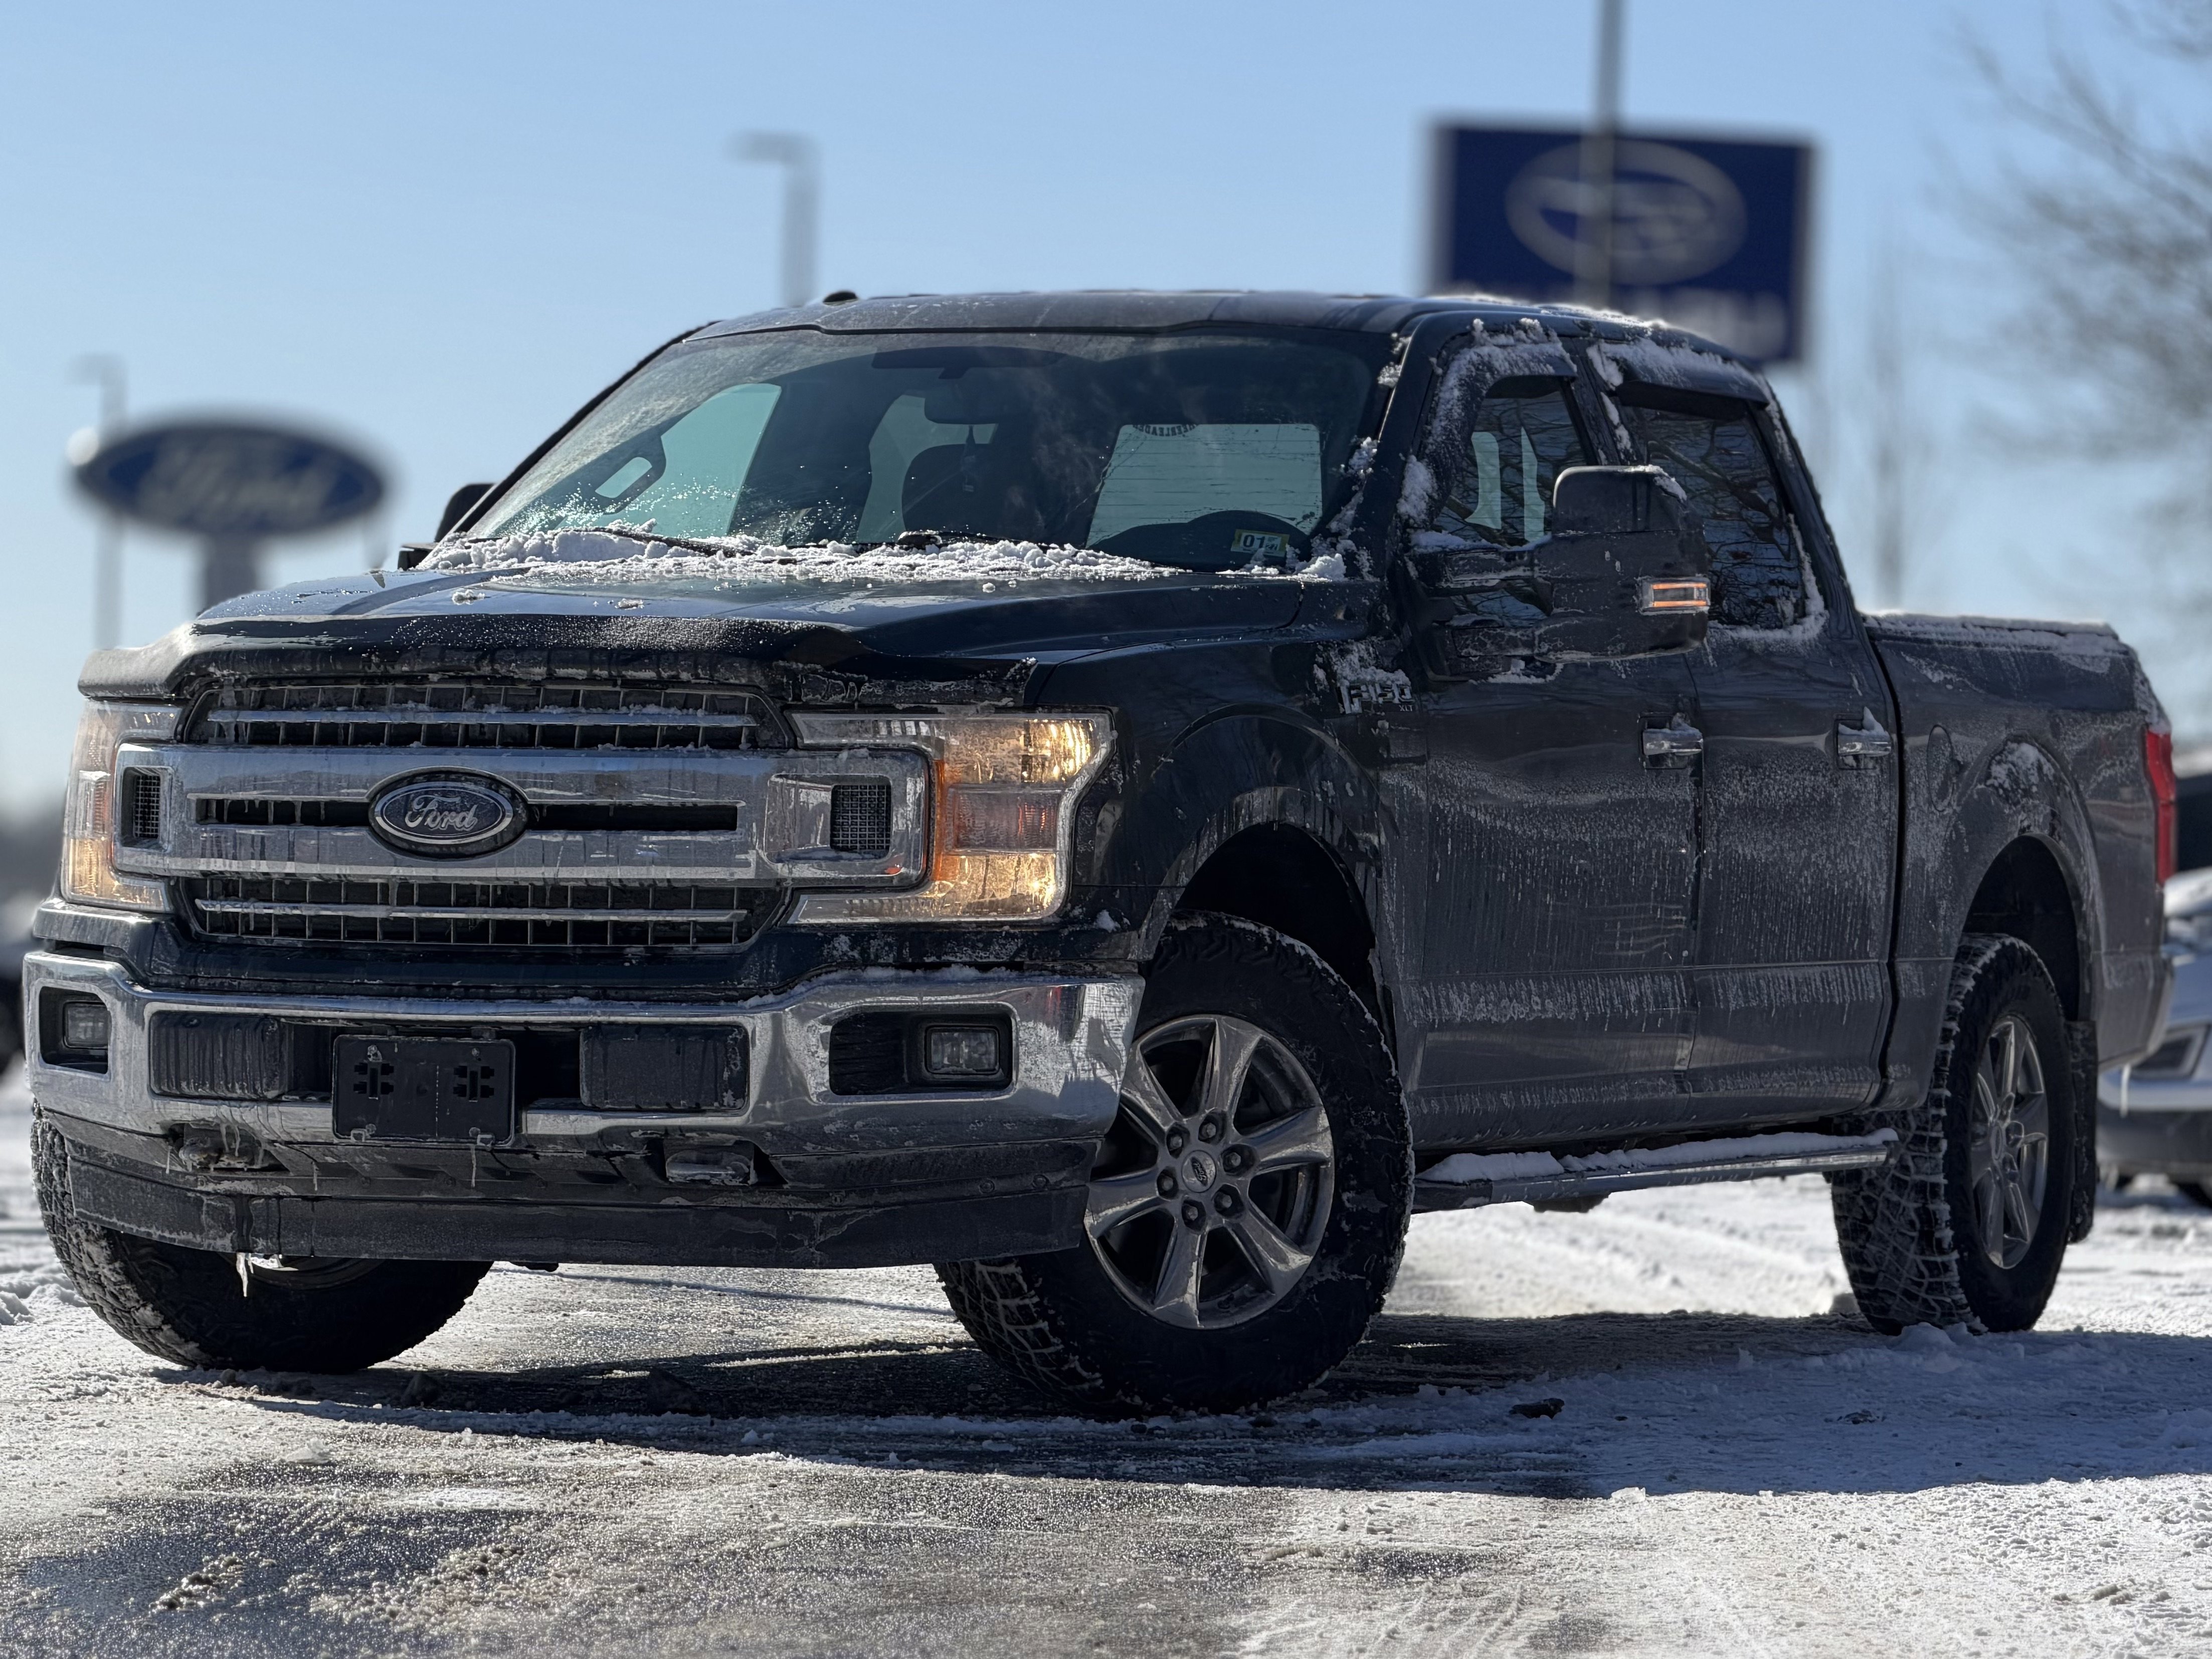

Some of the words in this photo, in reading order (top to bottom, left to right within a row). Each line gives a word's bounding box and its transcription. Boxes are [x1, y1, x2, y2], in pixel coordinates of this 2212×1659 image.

[1243, 534, 1266, 549] 01
[405, 794, 478, 831] Ford
[1192, 1161, 1207, 1181] Ford
